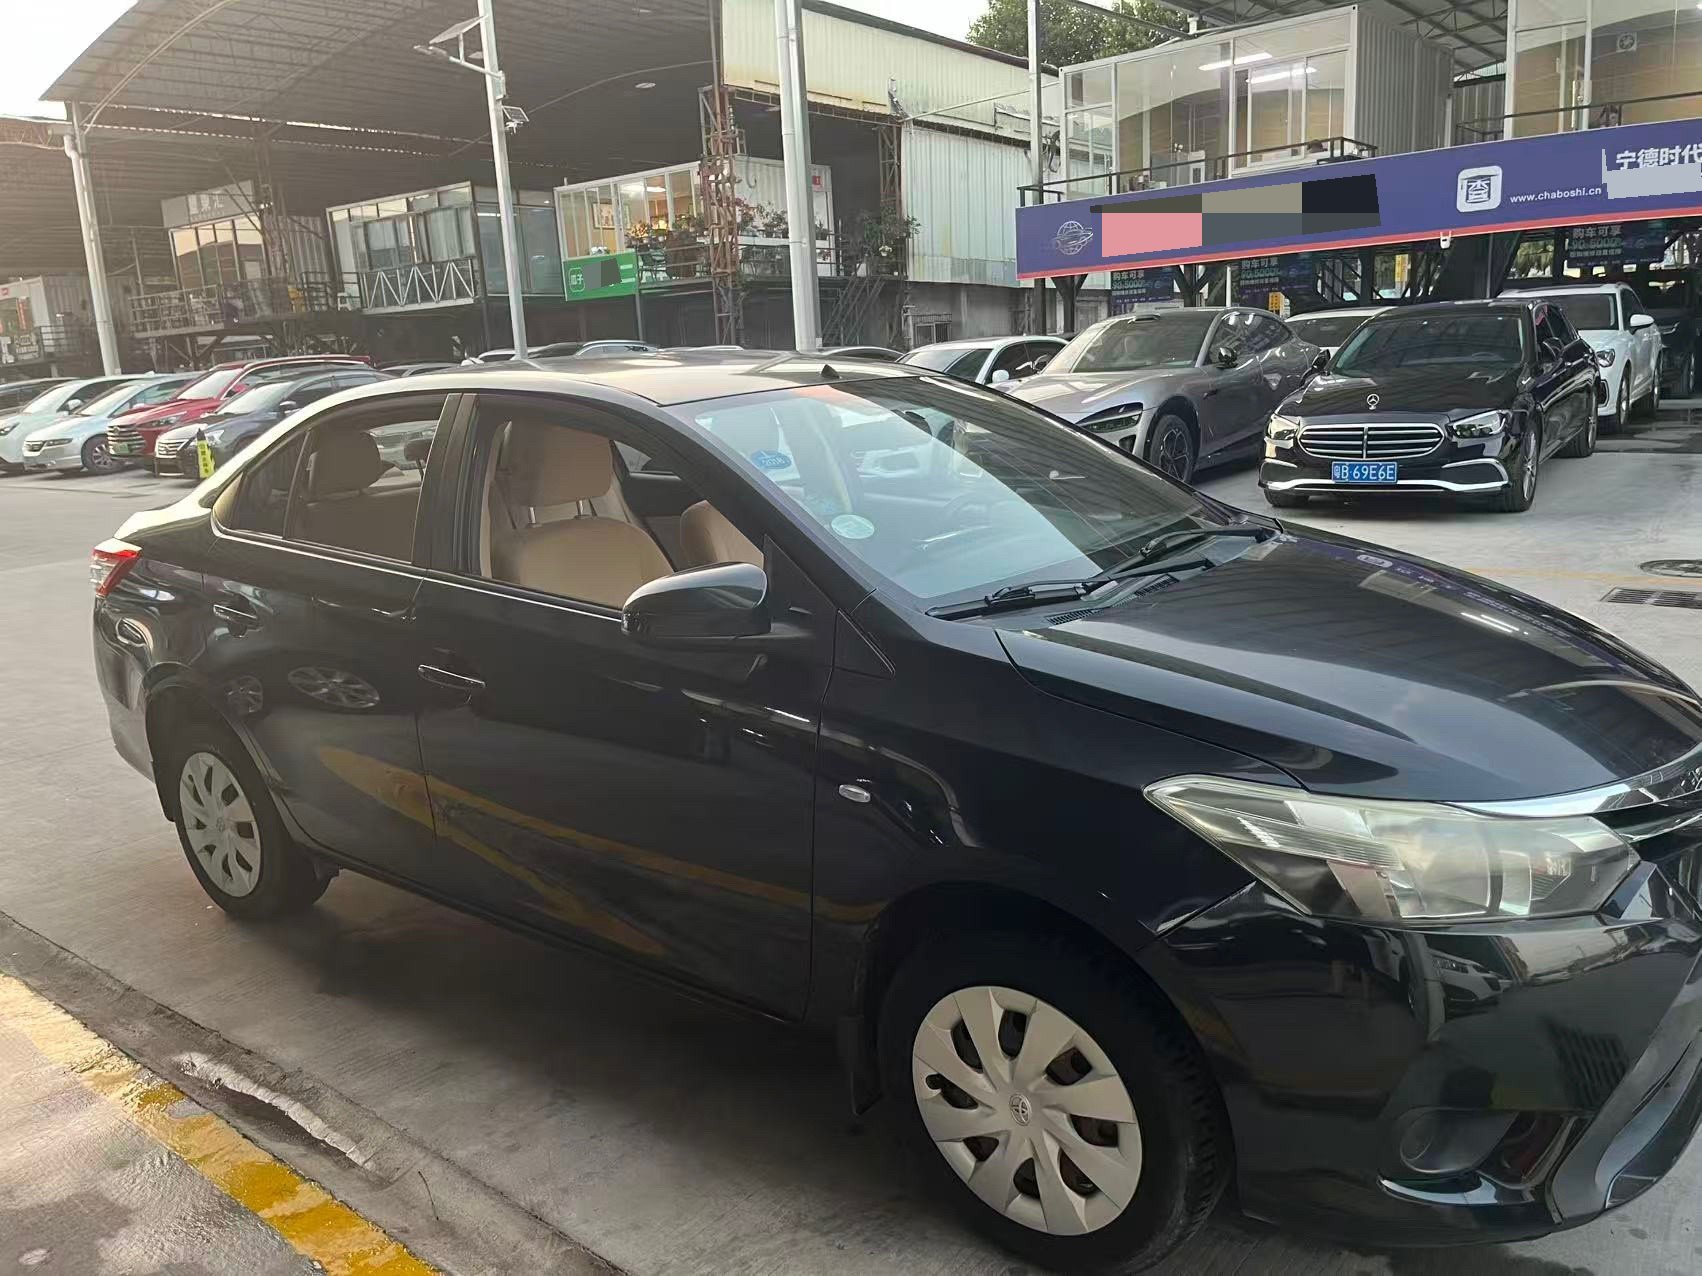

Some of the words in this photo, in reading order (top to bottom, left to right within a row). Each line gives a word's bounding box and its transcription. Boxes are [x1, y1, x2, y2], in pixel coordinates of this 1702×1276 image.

[1616, 143, 1702, 170] 宁德时代
[1510, 187, 1602, 203] www.chaboshi.cn
[1573, 225, 1621, 239] 购车可享
